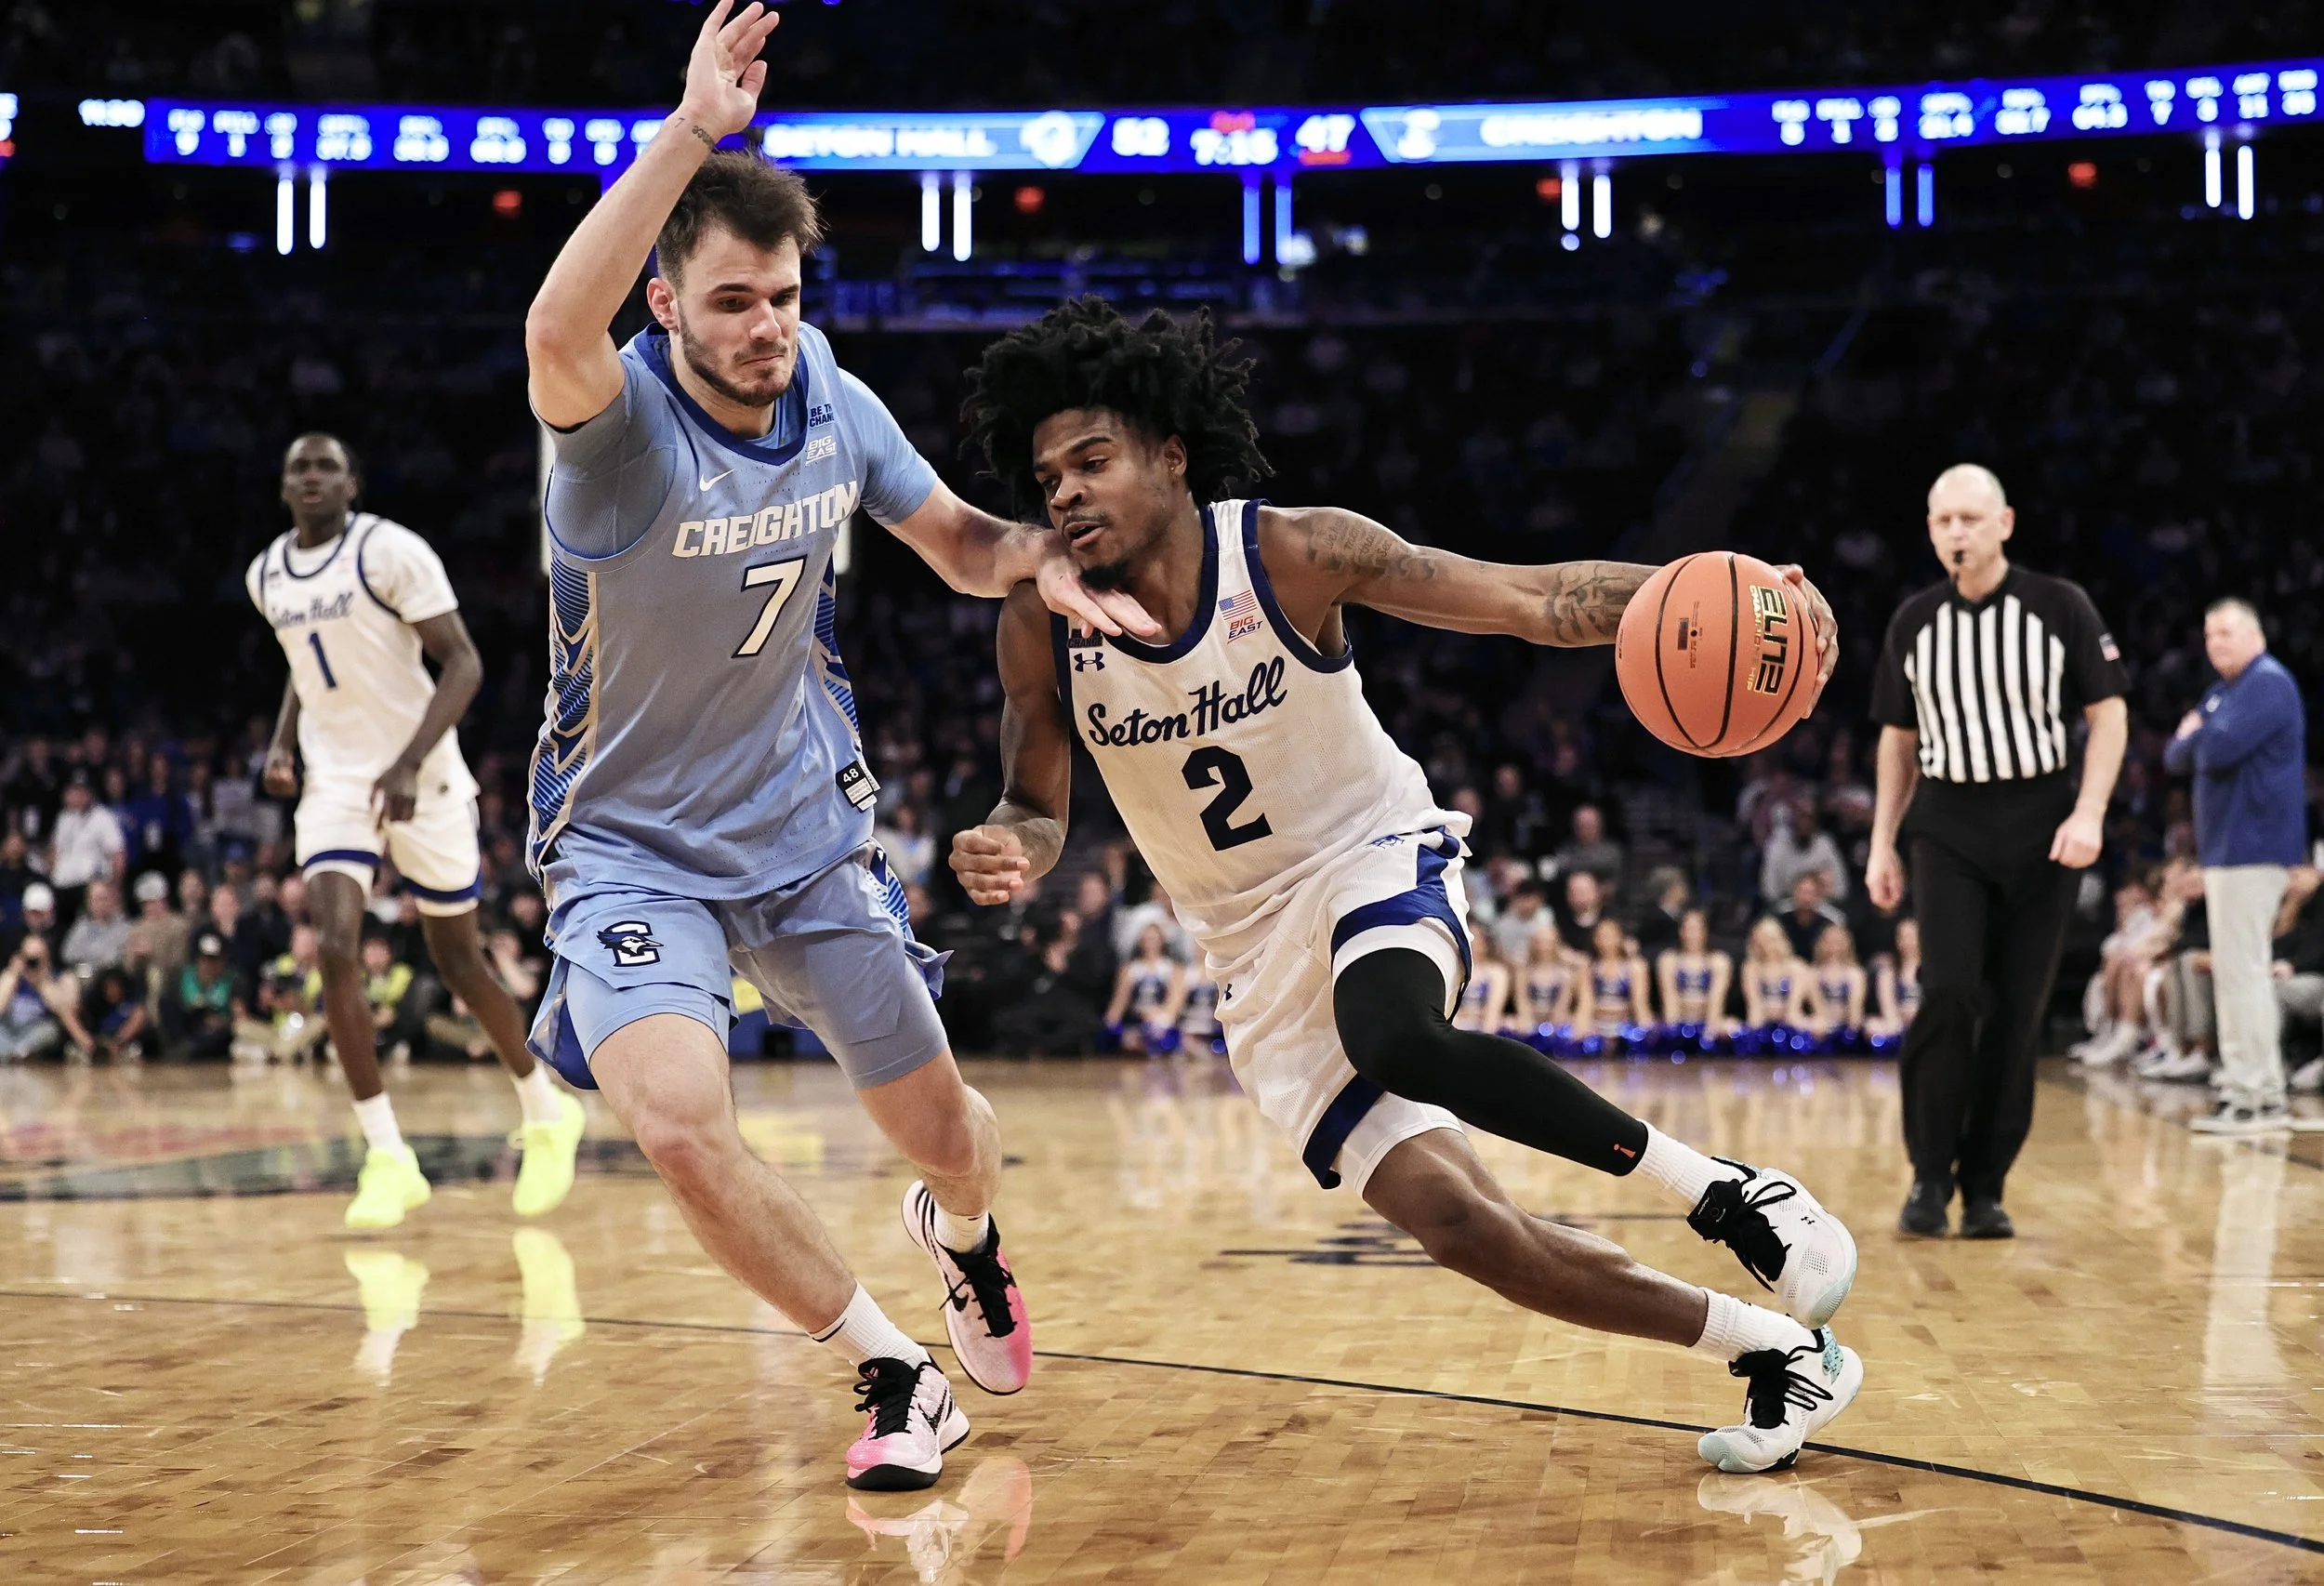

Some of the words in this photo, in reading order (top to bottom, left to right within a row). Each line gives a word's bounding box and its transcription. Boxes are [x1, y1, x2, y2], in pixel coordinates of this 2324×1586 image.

[811, 406, 823, 417] BE
[807, 442, 837, 459] EAST
[809, 435, 832, 451] BIG
[671, 481, 858, 559] CREIGHTON
[731, 554, 808, 659] 7
[1228, 620, 1263, 639] EAST
[1230, 615, 1254, 630] BIG
[309, 631, 337, 689] 1
[1088, 703, 1190, 747] Seton
[1188, 655, 1287, 737] Hall
[843, 768, 859, 783] 48
[1182, 746, 1273, 852] 2
